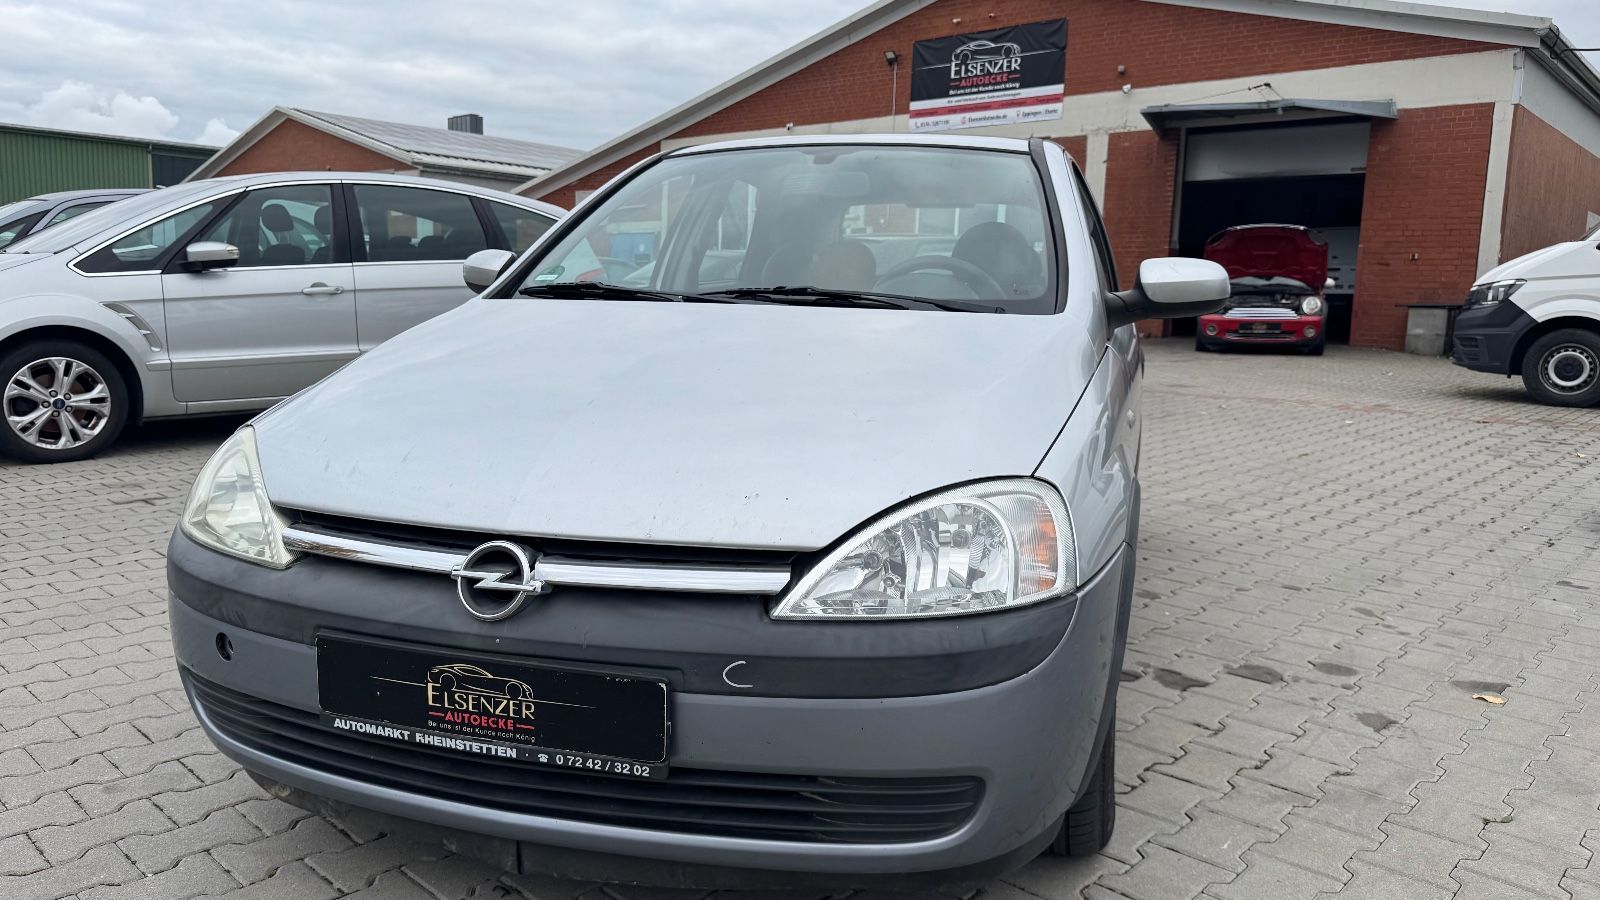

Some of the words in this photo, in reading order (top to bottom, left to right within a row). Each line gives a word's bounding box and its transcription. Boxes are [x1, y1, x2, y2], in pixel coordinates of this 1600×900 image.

[950, 57, 1021, 79] ELSENZER
[959, 74, 1009, 87] AUTOECKE
[427, 682, 535, 720] ELSENZER
[427, 720, 438, 728] Be
[445, 710, 514, 731] AUTOECKE
[334, 718, 410, 741] AUTOMARKT
[415, 732, 517, 759] RHEINSTETTEN
